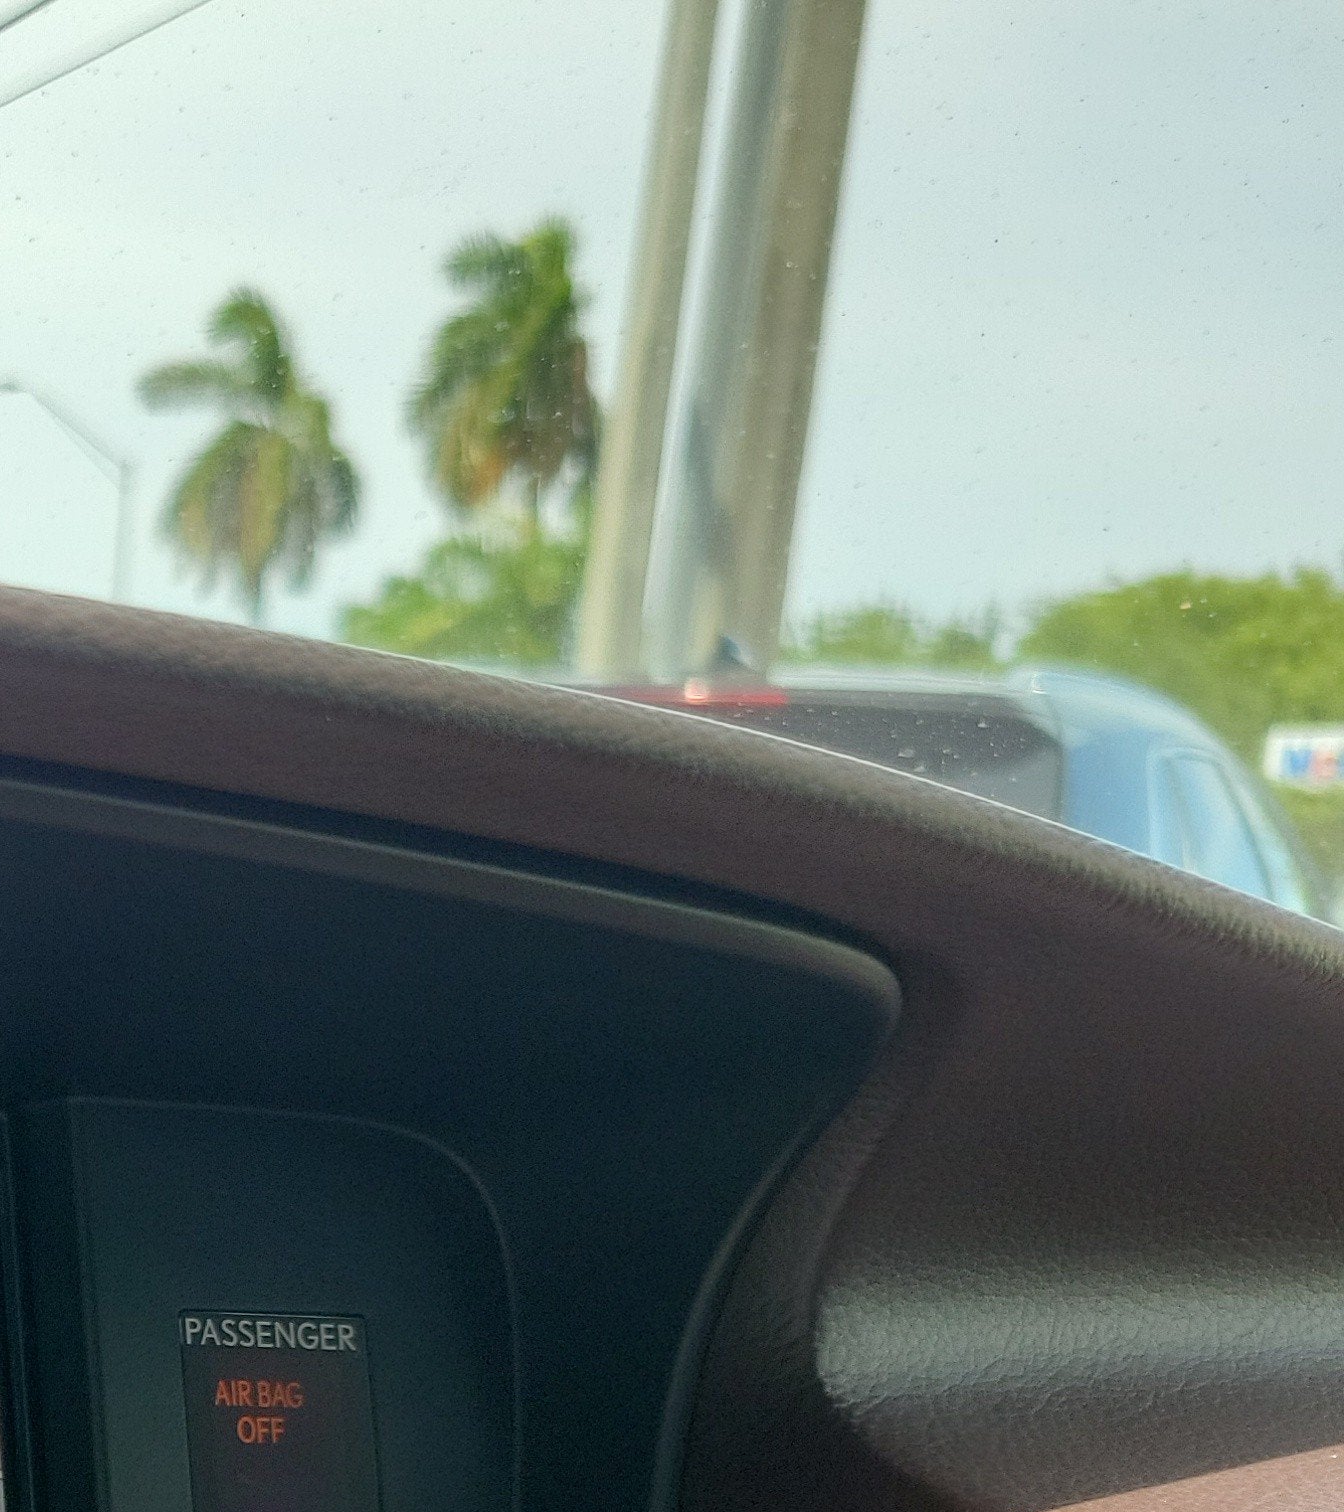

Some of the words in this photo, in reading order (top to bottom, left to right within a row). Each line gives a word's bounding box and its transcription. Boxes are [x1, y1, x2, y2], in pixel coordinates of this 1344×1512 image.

[184, 1318, 356, 1351] PASSENGER
[214, 1379, 252, 1408] AIR
[257, 1381, 304, 1408] BAG
[237, 1415, 285, 1444] OFF
